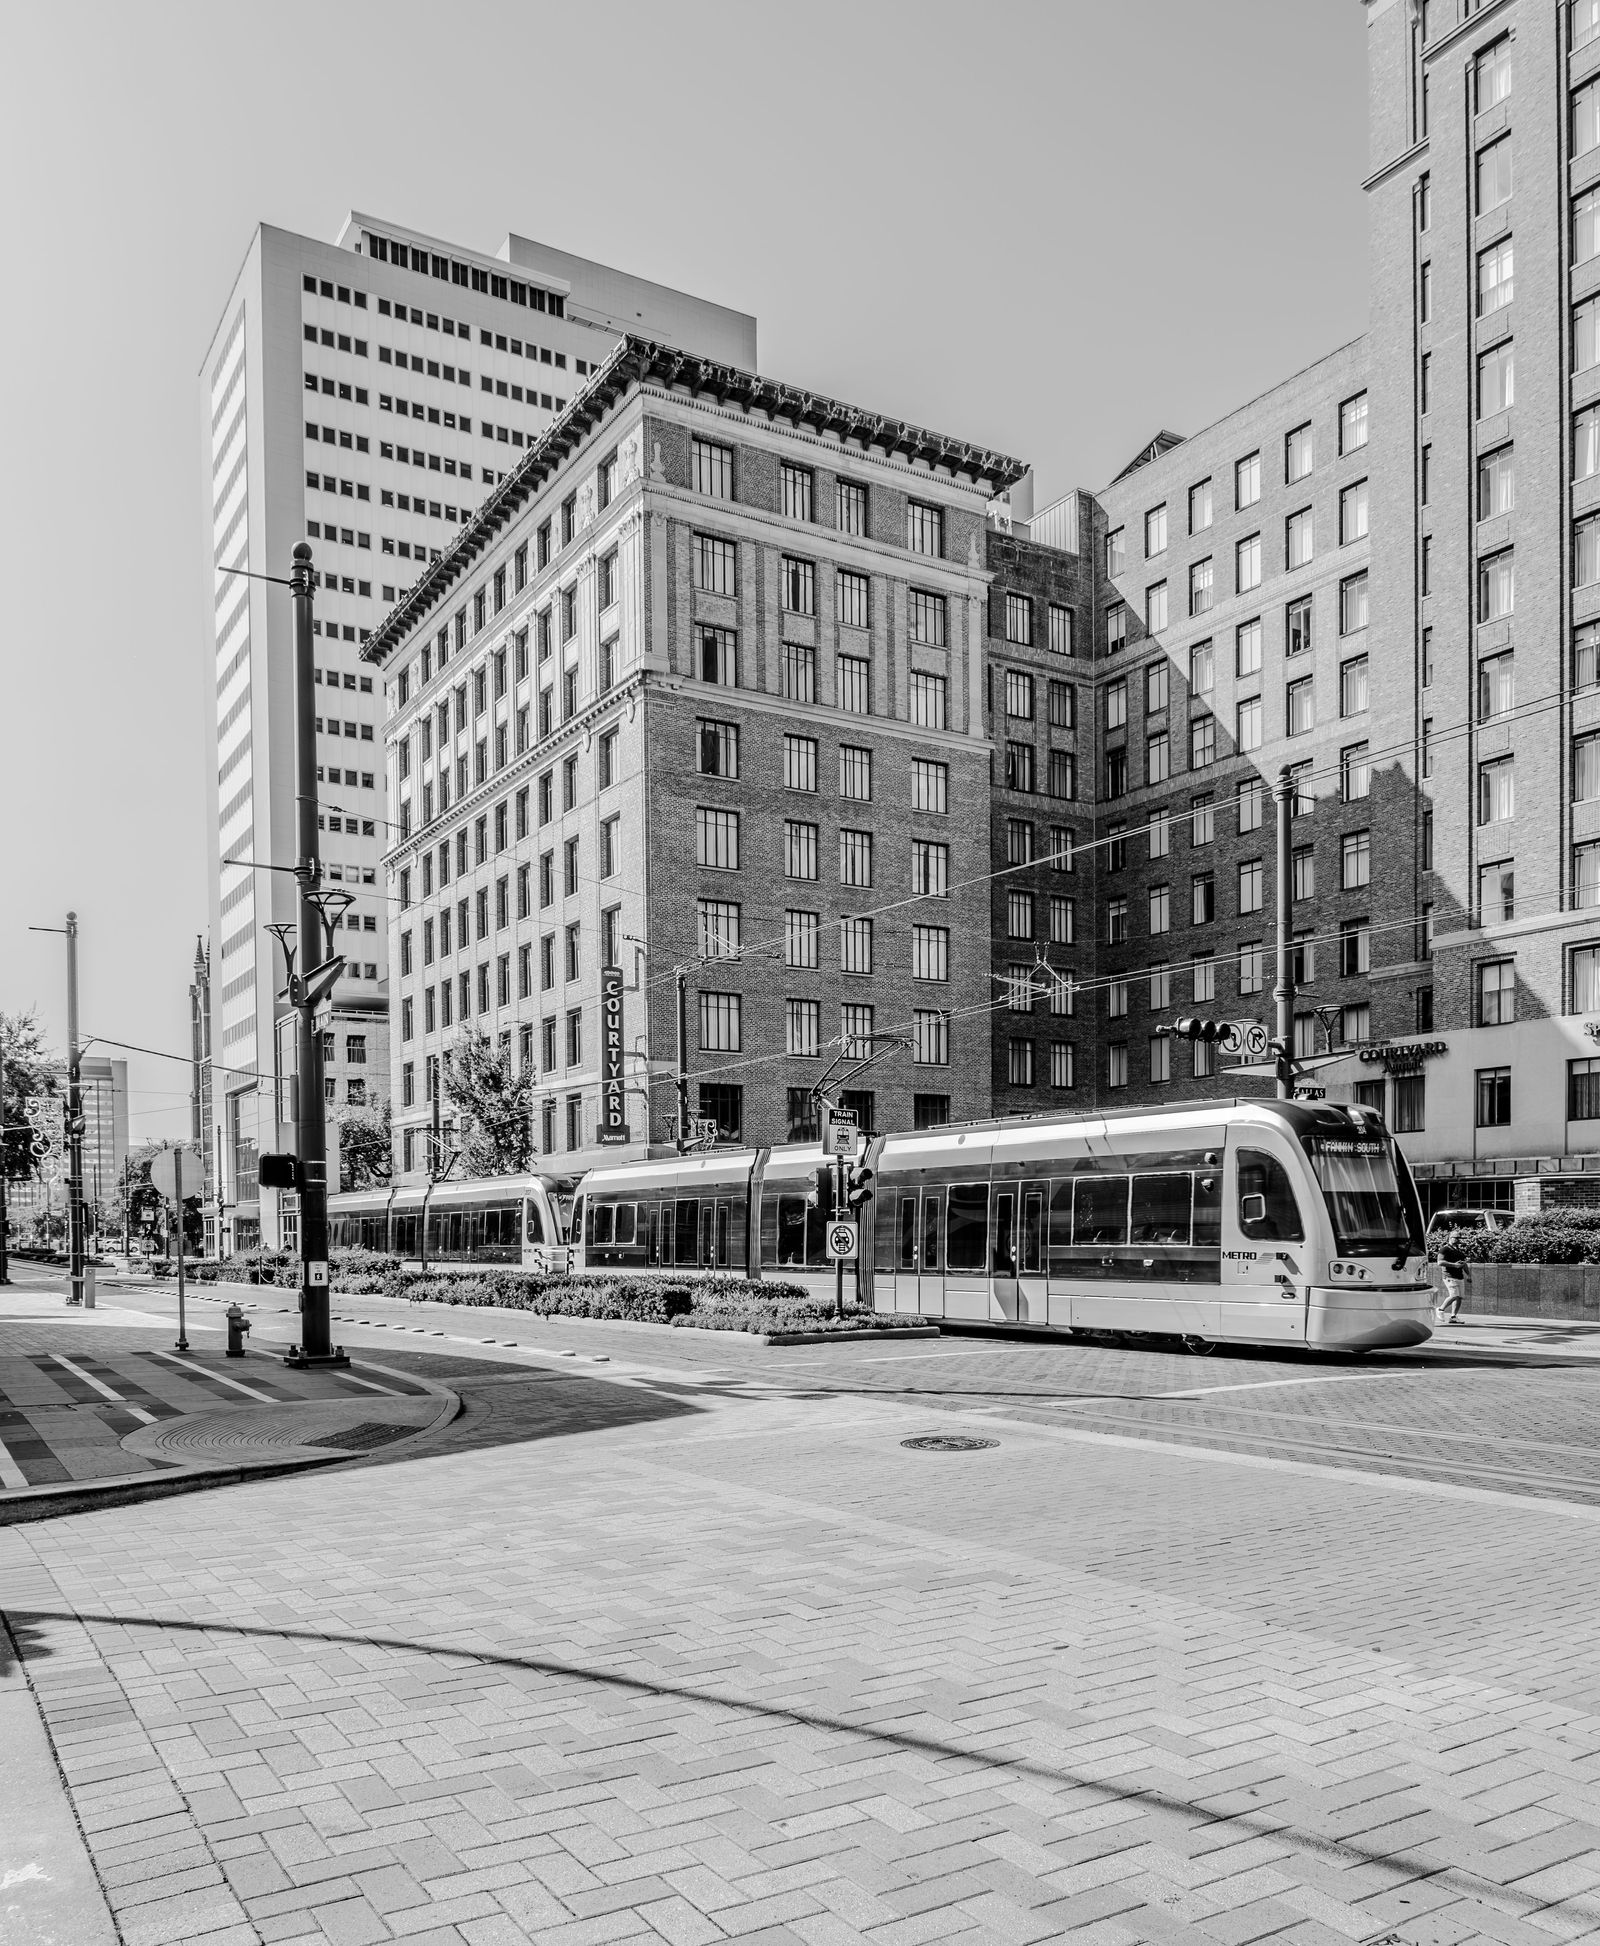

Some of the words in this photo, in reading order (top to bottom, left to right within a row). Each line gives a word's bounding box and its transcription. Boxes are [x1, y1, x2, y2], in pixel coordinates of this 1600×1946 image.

[606, 980, 622, 1127] COURTYARD
[1359, 1041, 1448, 1063] COURTYARD
[833, 1110, 853, 1118] TRAIN
[831, 1117, 855, 1126] SIGNAL
[601, 1133, 626, 1142] Marriott
[1357, 1142, 1380, 1153] SOUTH
[1222, 1251, 1257, 1260] METRO
